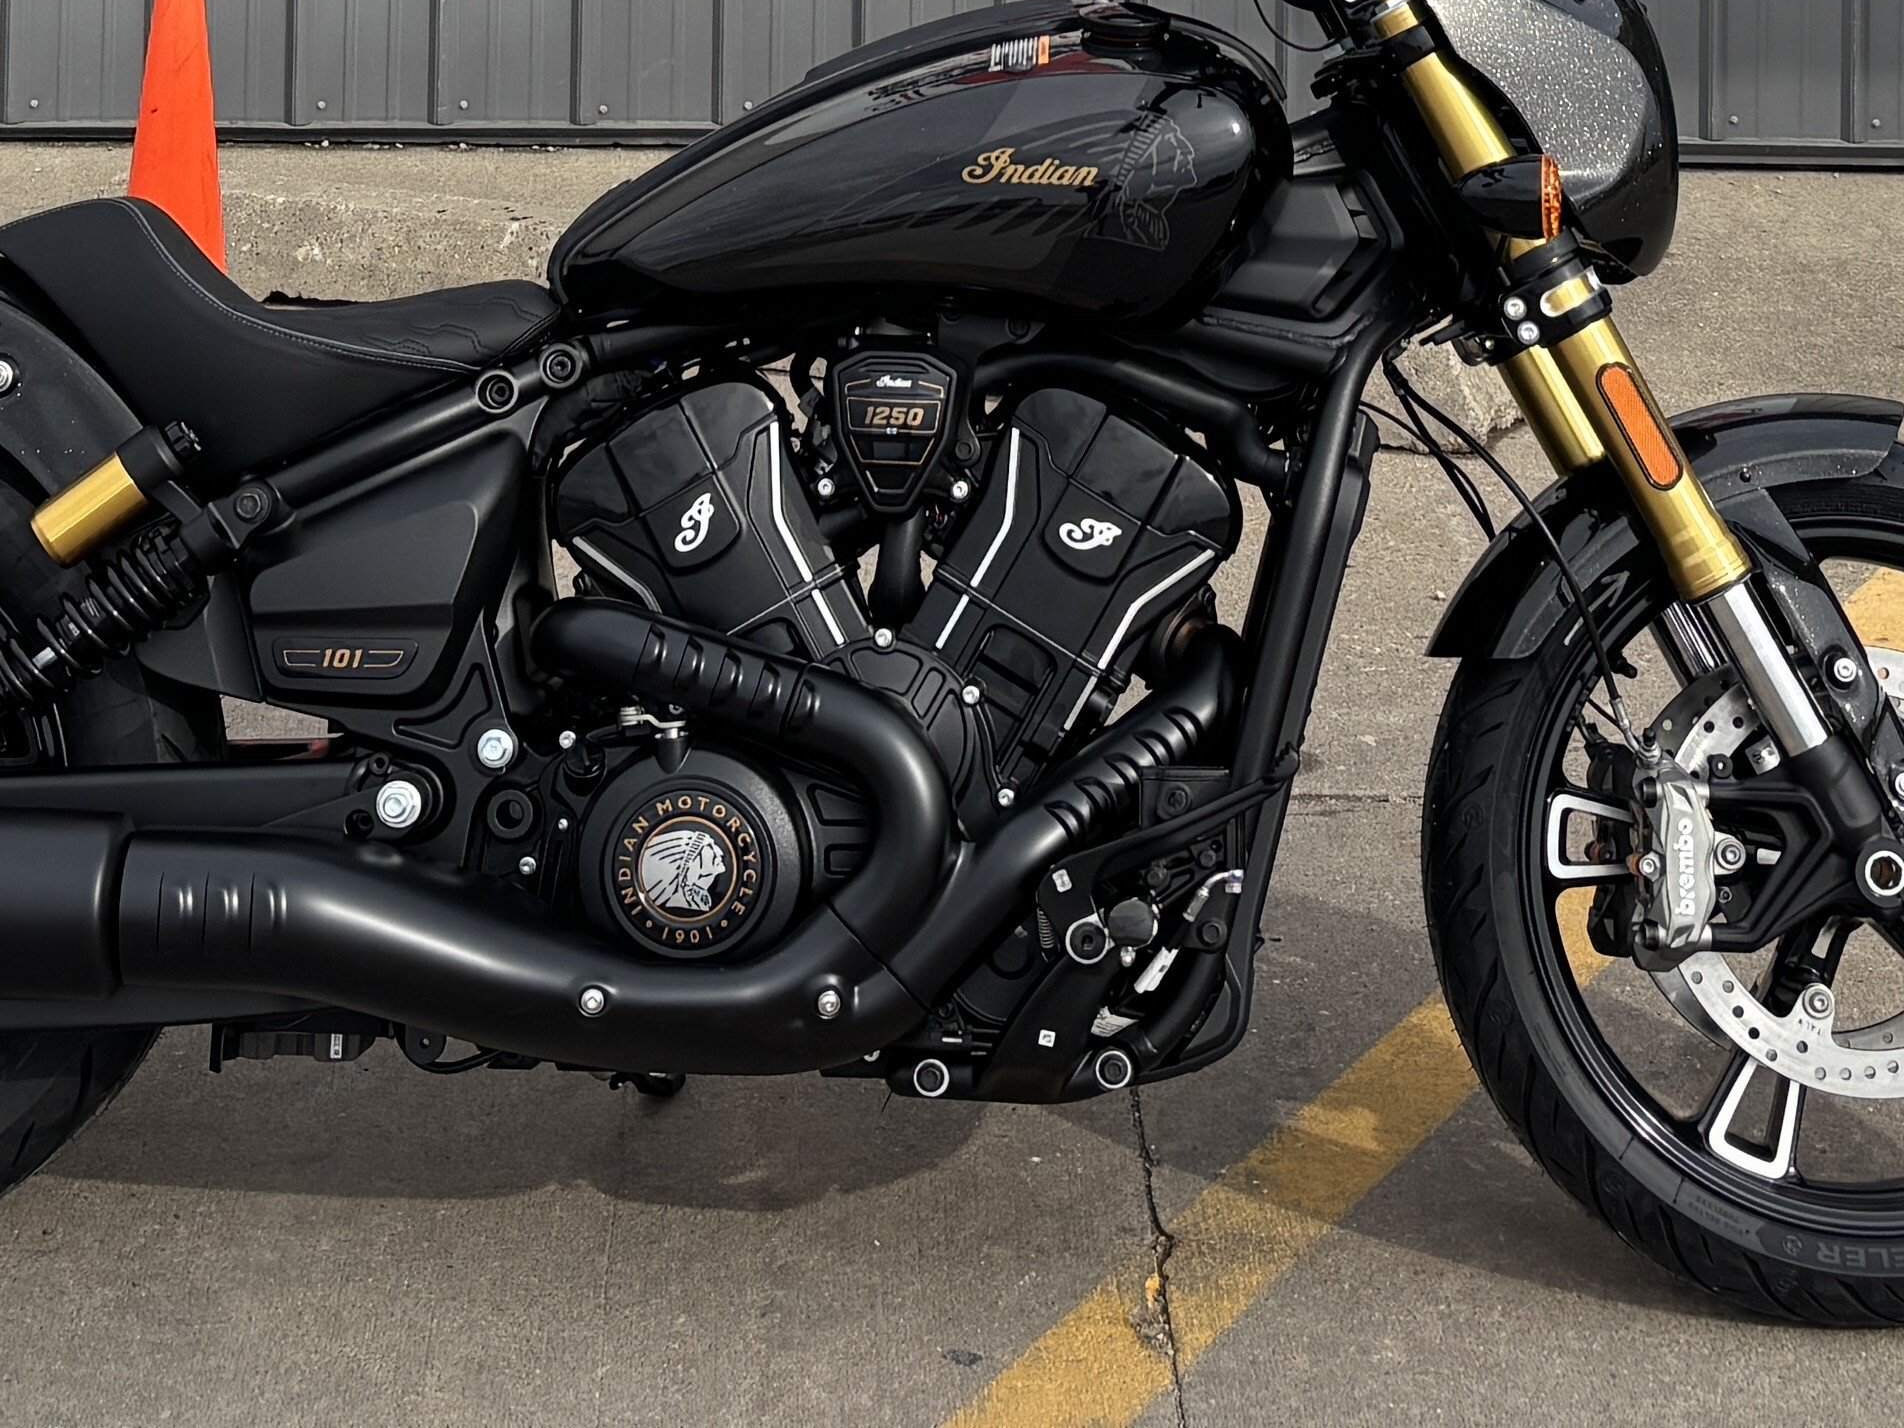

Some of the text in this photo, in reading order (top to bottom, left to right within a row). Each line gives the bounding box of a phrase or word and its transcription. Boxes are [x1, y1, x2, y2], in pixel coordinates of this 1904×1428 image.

[962, 147, 1098, 186] Indian
[864, 406, 924, 426] 1250
[322, 649, 363, 668] 101
[618, 795, 757, 916] INDIAN MOTORCYCLE
[1673, 817, 1696, 917] brembo
[661, 926, 713, 943] 1901
